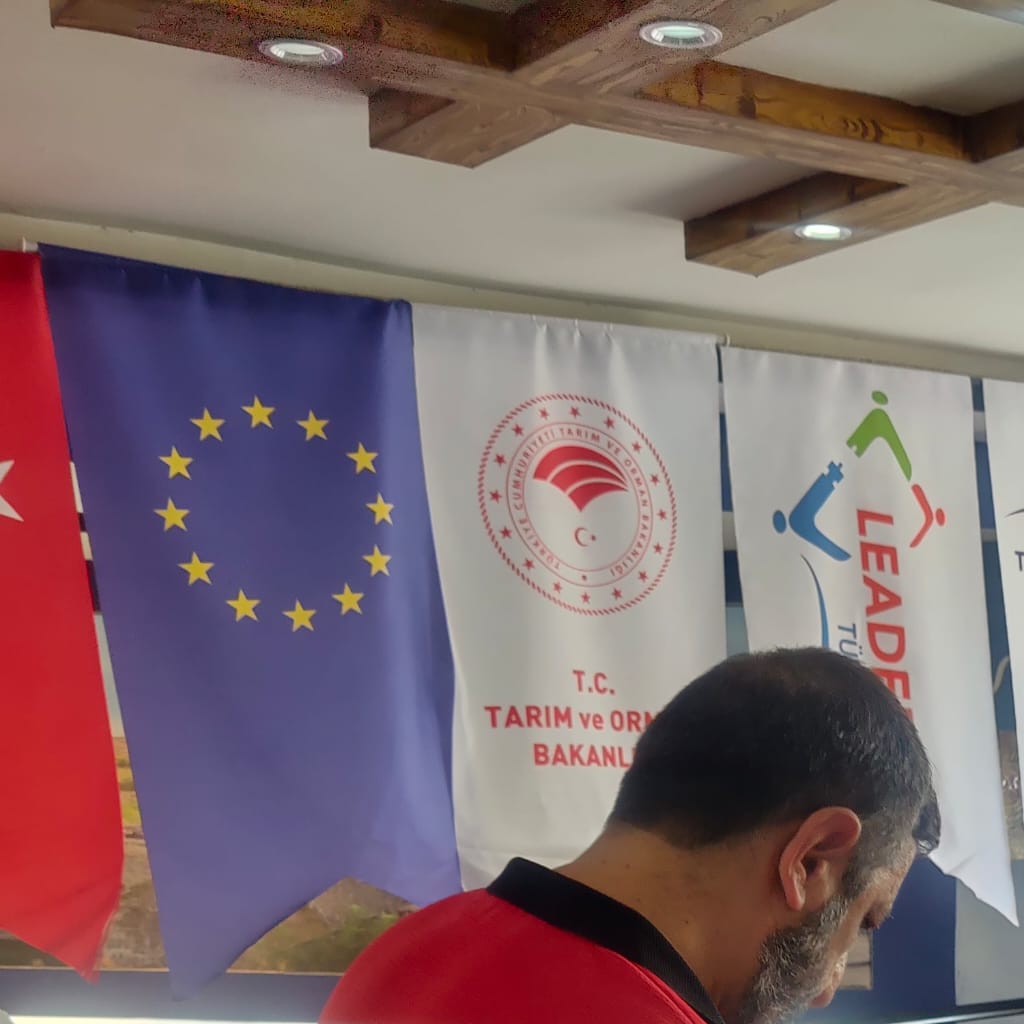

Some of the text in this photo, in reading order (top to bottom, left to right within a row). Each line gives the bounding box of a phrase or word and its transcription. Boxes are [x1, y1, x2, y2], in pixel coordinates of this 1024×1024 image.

[559, 427, 601, 443] TARIM
[606, 439, 622, 456] VE
[623, 458, 649, 508] ORMAN
[856, 508, 914, 722] LEADE
[572, 669, 616, 696] T.C.
[484, 704, 574, 729] TARIM
[579, 712, 605, 731] ve
